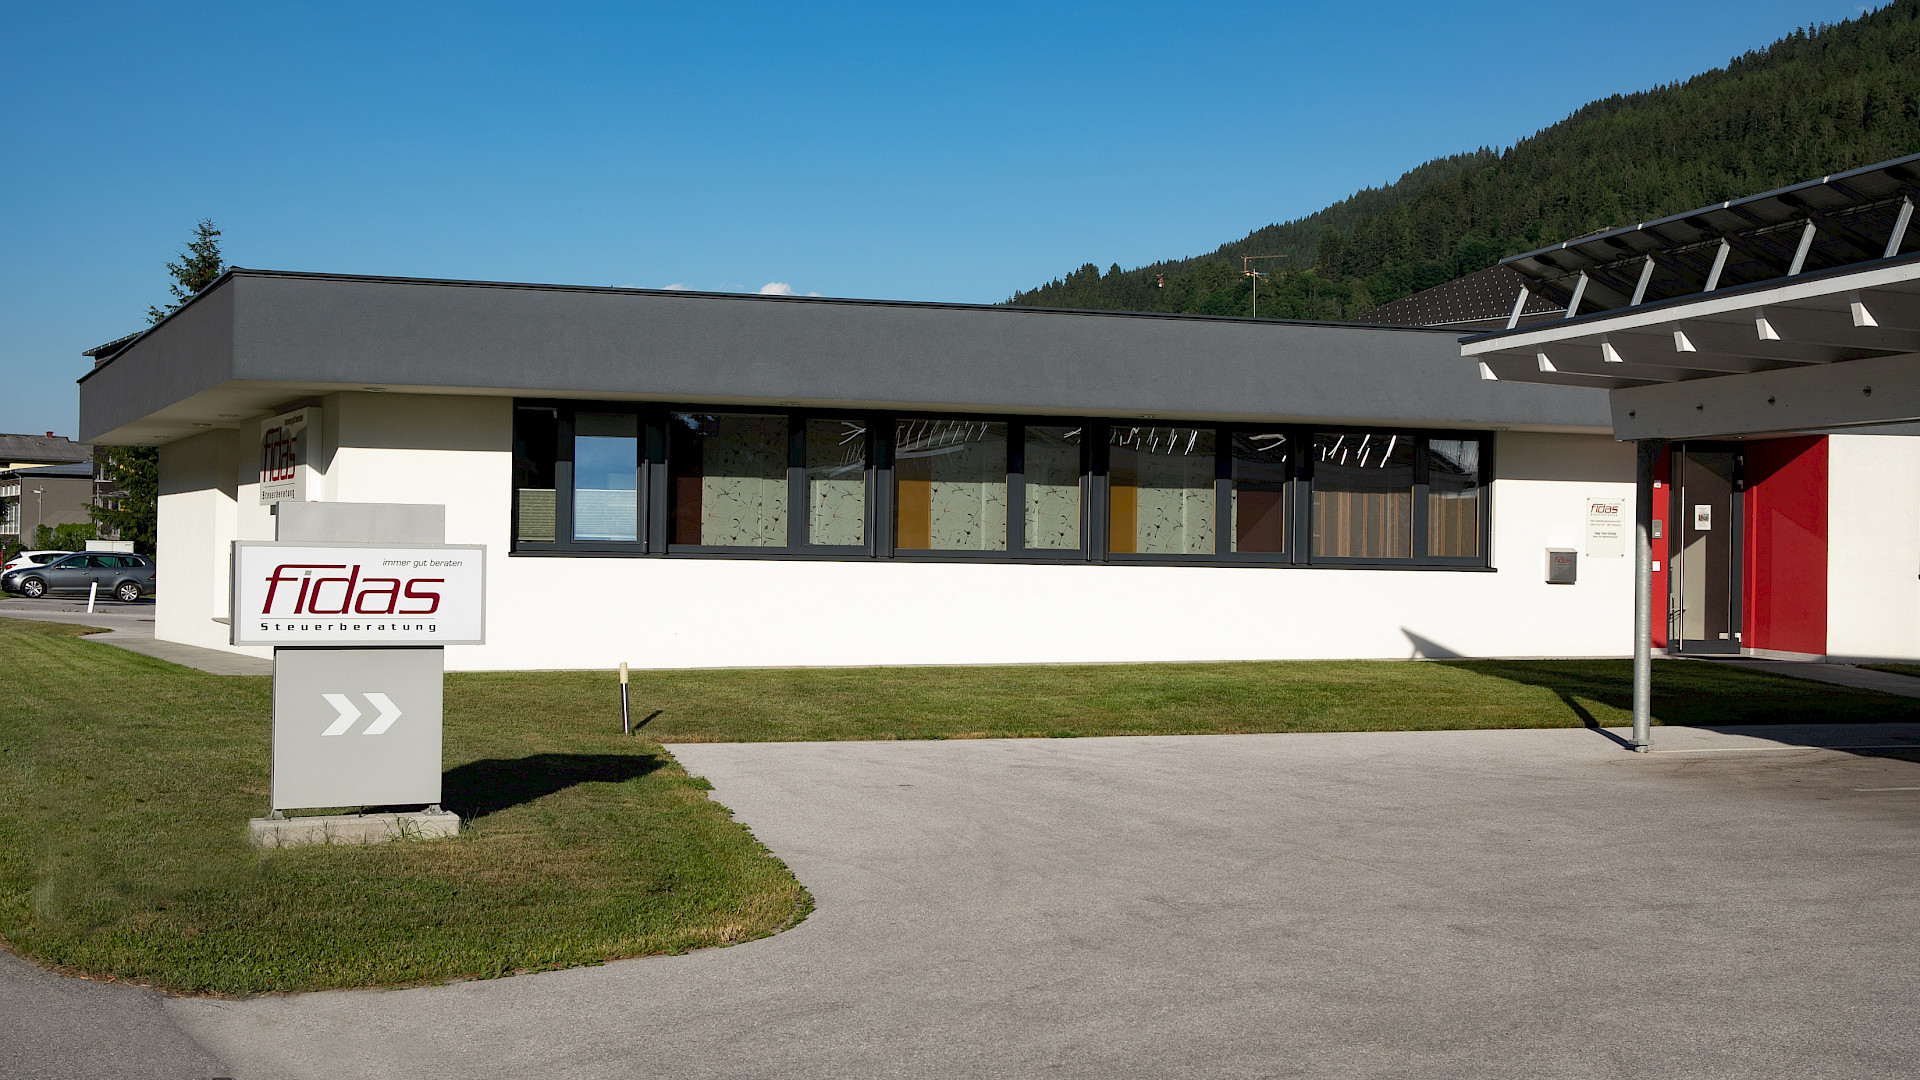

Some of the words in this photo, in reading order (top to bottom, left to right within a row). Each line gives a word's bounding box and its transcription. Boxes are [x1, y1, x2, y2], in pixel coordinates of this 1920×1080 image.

[263, 427, 296, 482] fidas
[1591, 504, 1618, 514] fidas
[413, 559, 427, 569] gut
[430, 559, 463, 567] beraten
[261, 564, 445, 615] fidas
[260, 622, 437, 633] Steuerberatung
